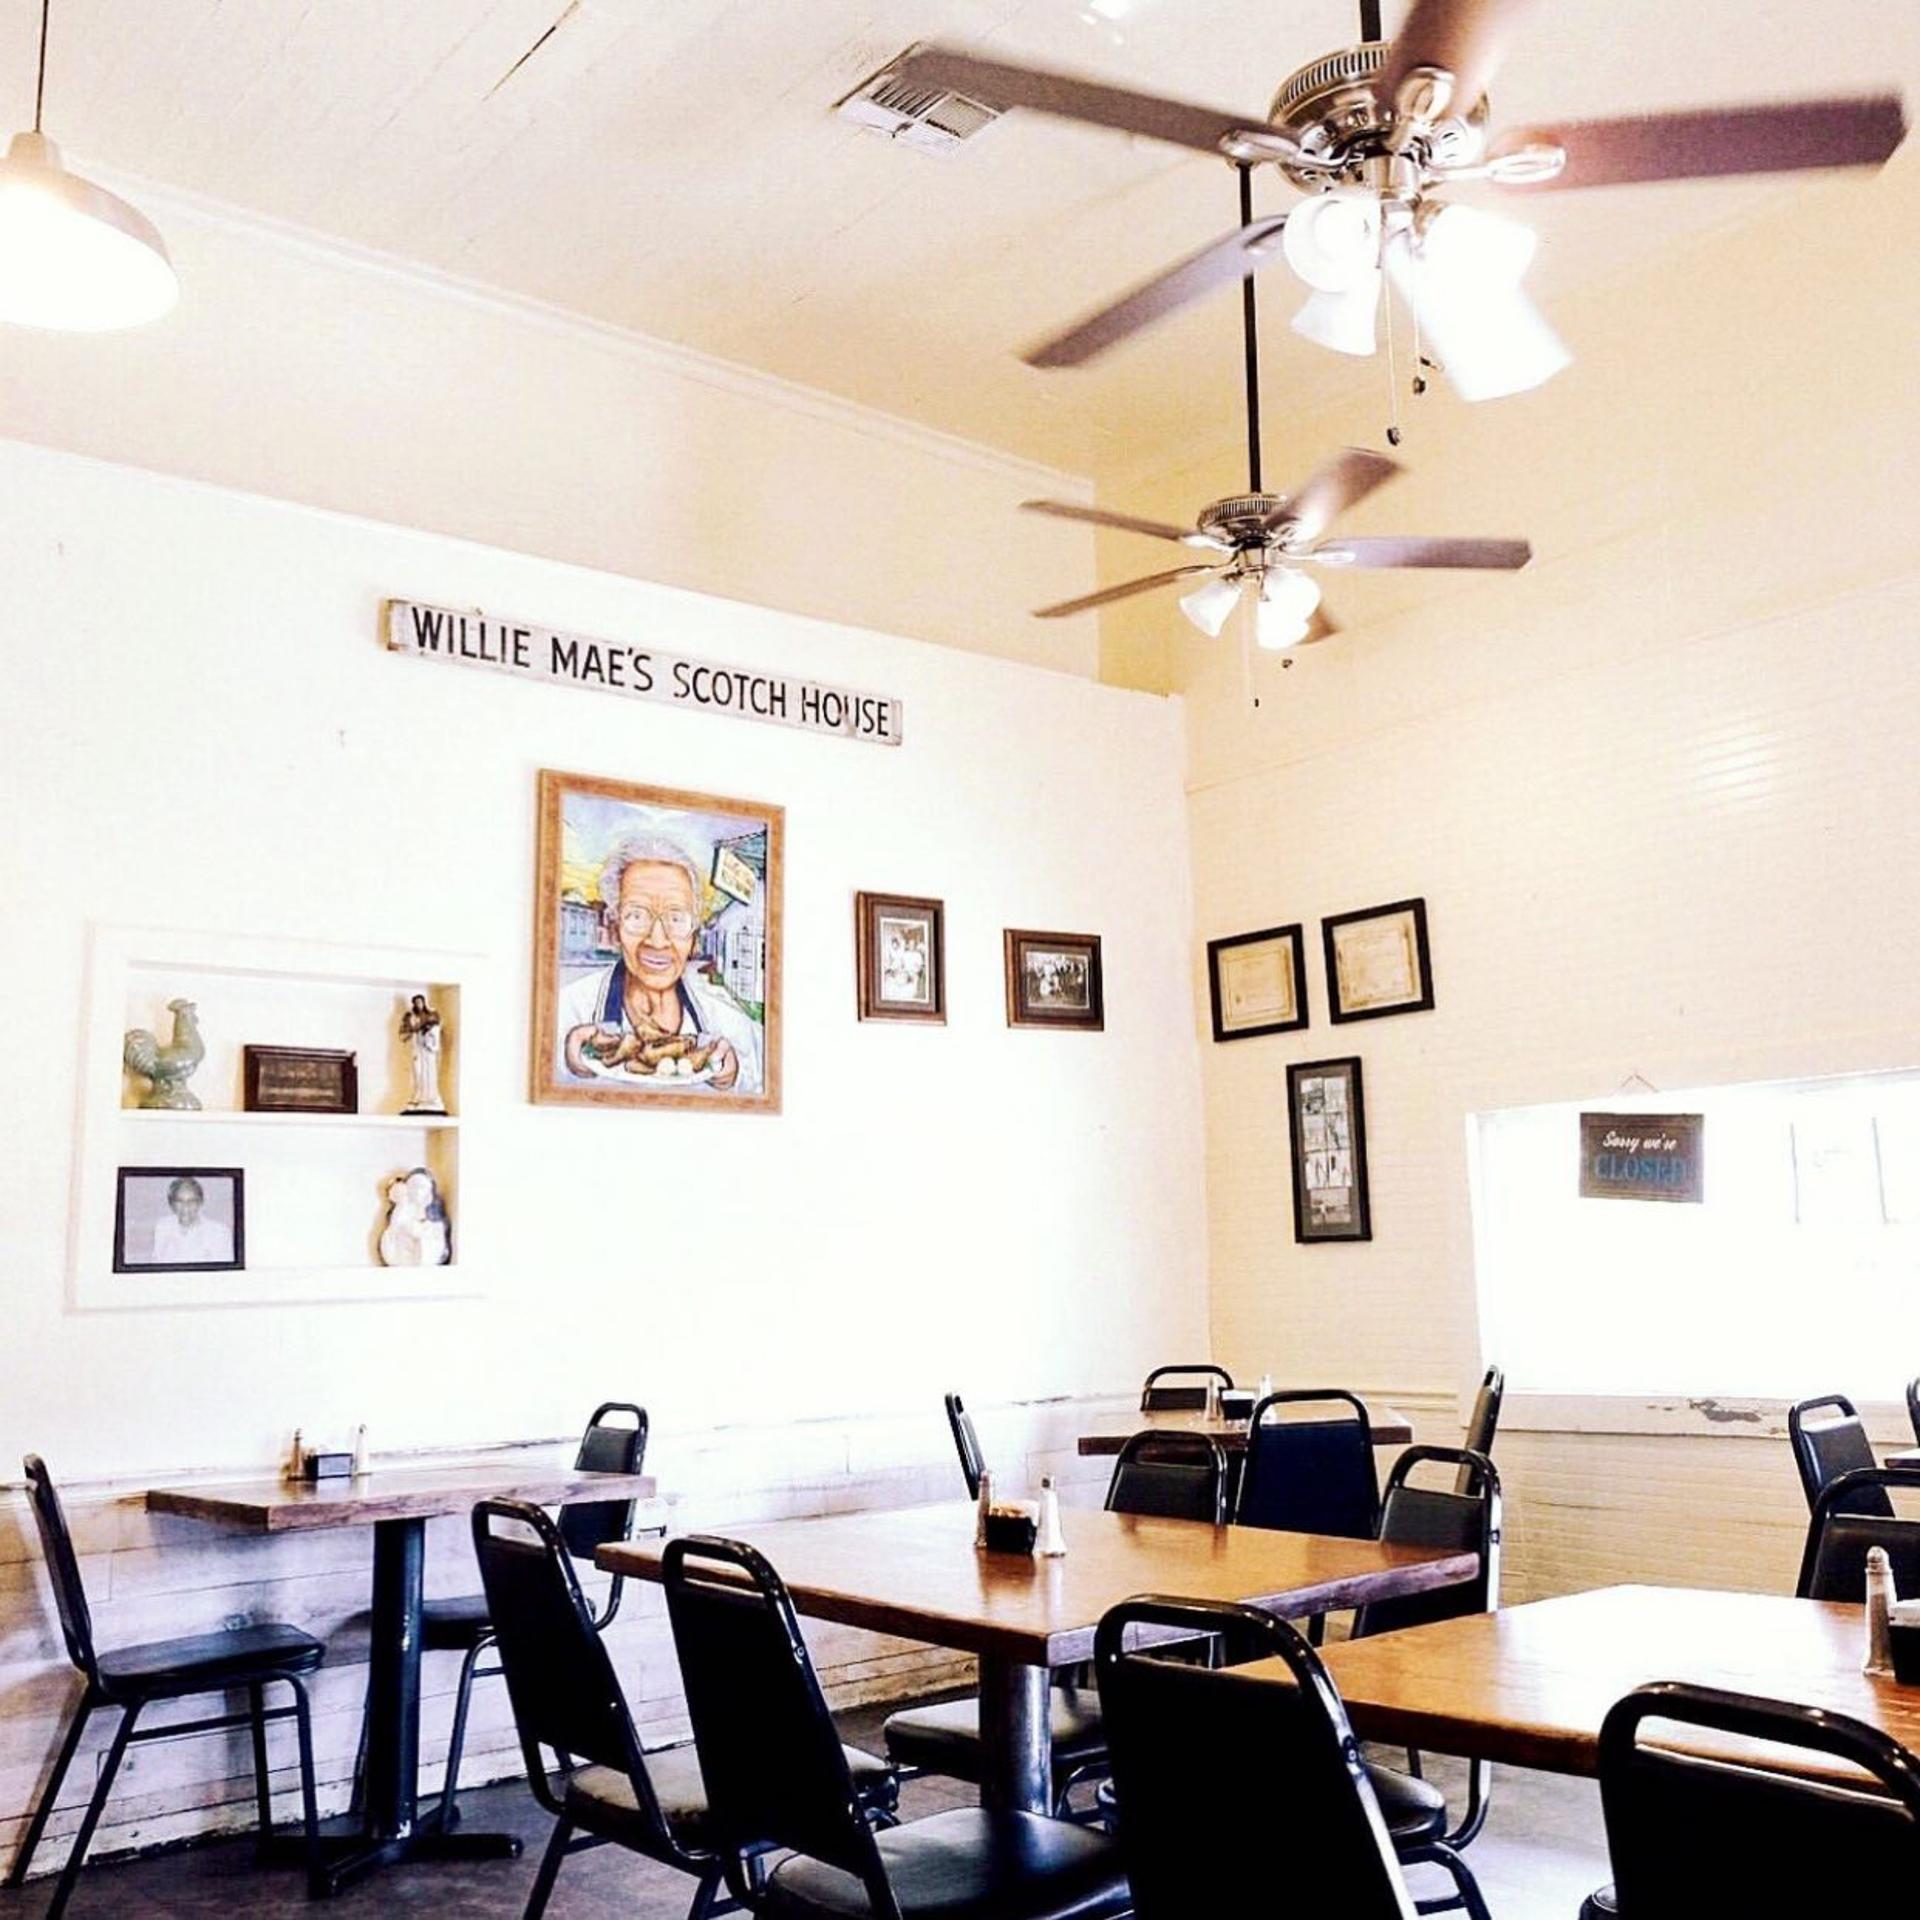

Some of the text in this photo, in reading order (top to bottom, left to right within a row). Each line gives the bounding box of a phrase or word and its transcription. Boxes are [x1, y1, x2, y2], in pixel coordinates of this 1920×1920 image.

[411, 606, 889, 737] WILLIE MAE'S SCOTCH HOUSE
[1603, 1130, 1678, 1153] Sorry we're
[1595, 1154, 1686, 1184] CLOSED
